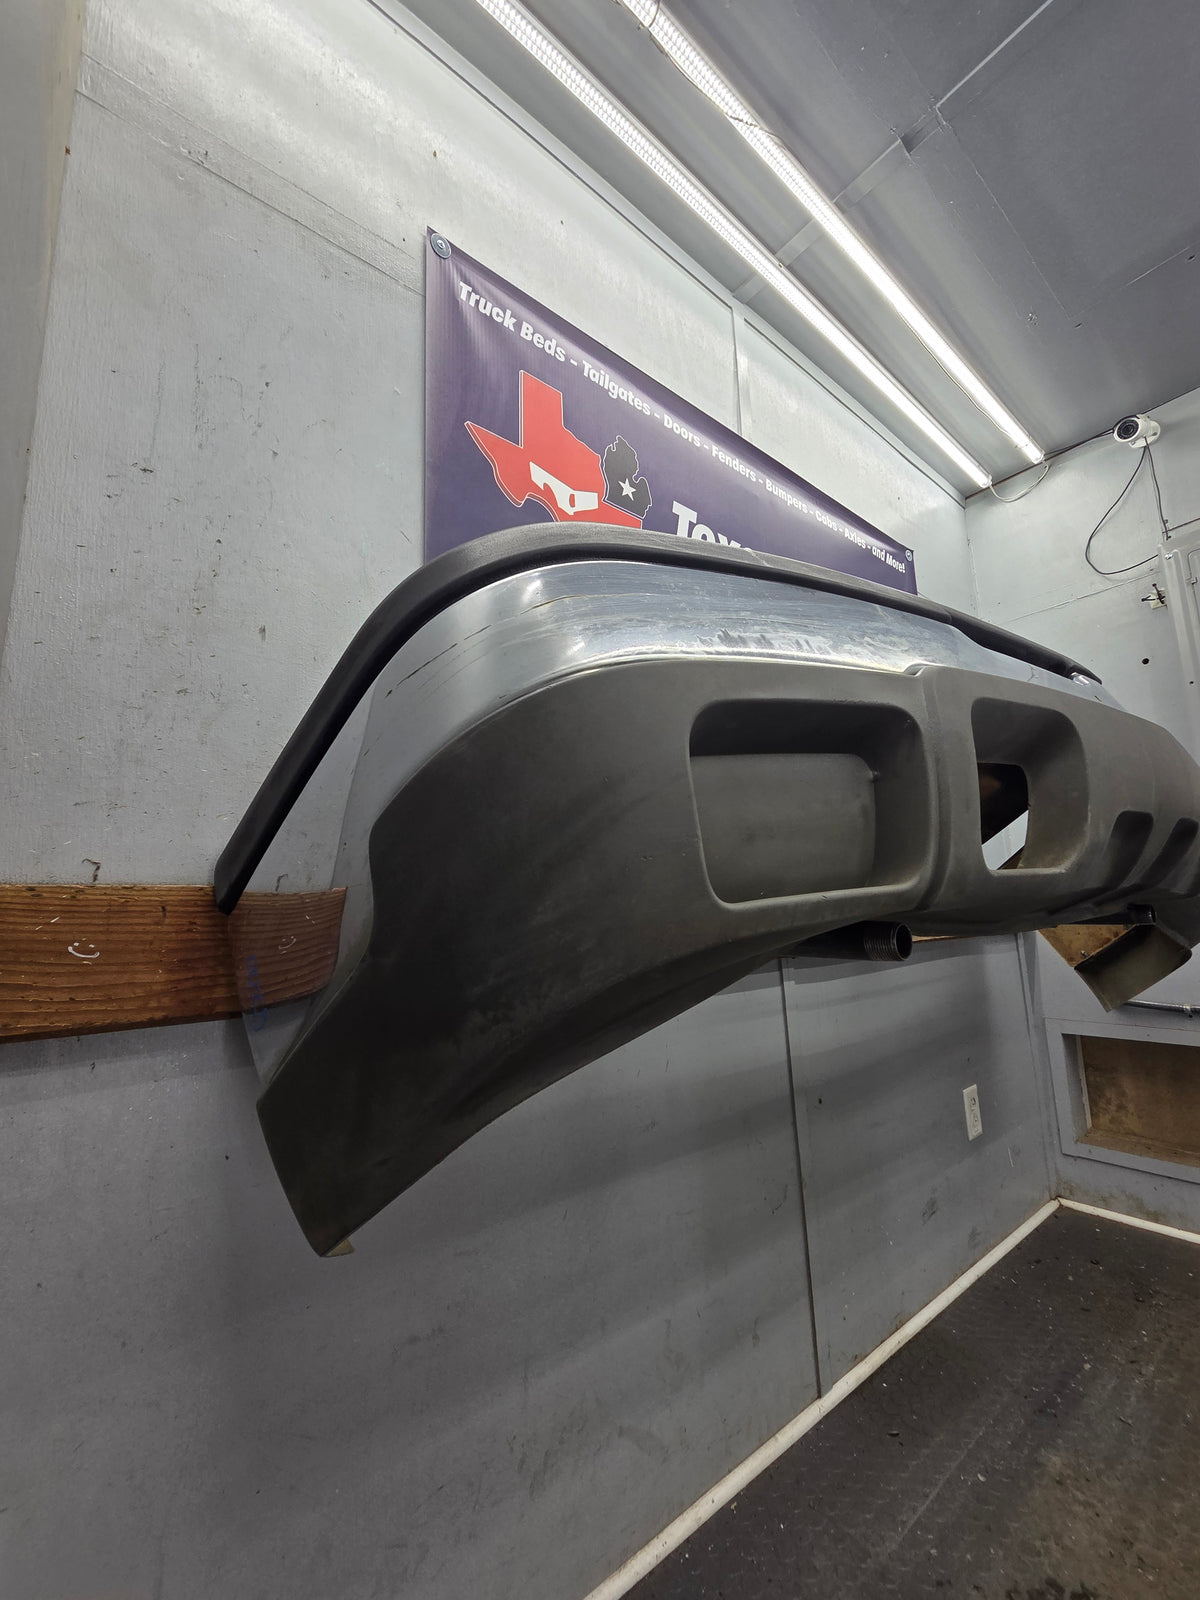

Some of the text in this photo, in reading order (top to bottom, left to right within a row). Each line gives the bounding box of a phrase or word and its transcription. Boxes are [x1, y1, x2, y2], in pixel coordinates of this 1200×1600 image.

[459, 281, 517, 332] Truck
[520, 321, 566, 362] Beds
[582, 360, 651, 416] Tailgates
[663, 415, 701, 448] Doors
[711, 445, 757, 482] Fenders
[765, 478, 808, 514] Bumpers
[815, 510, 838, 532] Cabs
[844, 528, 867, 549] Axles
[872, 546, 886, 562] and
[886, 552, 906, 574] More!
